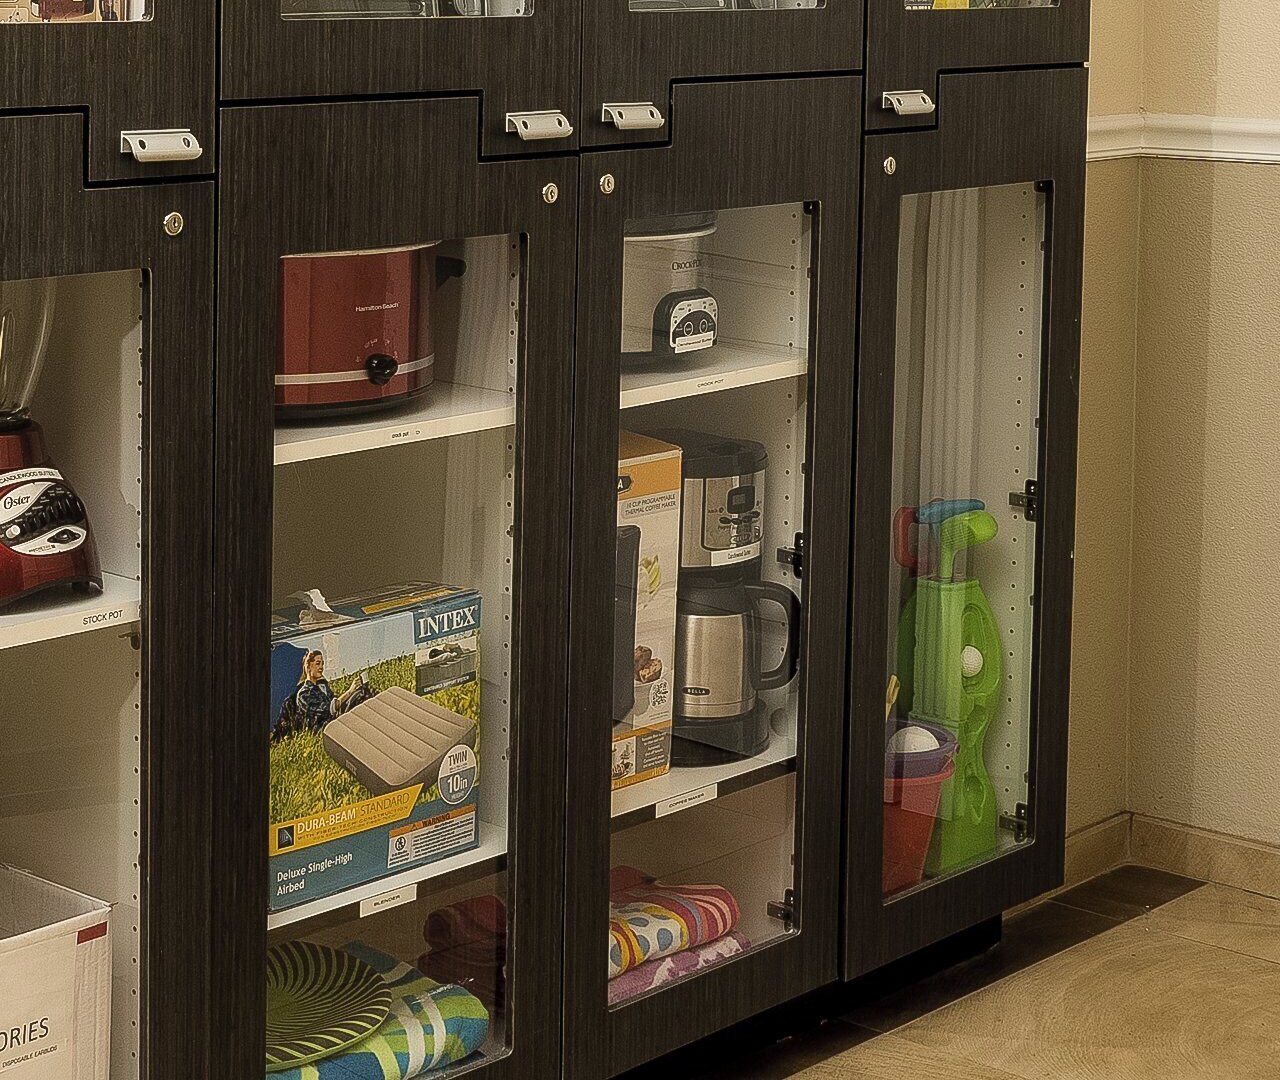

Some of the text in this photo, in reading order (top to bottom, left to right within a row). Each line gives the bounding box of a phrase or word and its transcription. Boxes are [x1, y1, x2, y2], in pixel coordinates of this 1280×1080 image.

[697, 380, 714, 388] CROCK
[4, 496, 30, 510] Oster
[661, 500, 676, 509] MAKER
[82, 610, 124, 626] STOCK POT
[418, 605, 476, 639] INTEX
[448, 750, 468, 766] TWIN
[297, 792, 410, 834] DURA-BEAM STANDARD
[358, 806, 408, 824] CONSTRUCTION
[422, 812, 452, 828] WARNING
[276, 852, 354, 882] Deluxe Single-High
[276, 880, 305, 897] Airbed
[373, 894, 401, 907] BLENDER
[2, 1052, 34, 1068] DISPOSABLE
